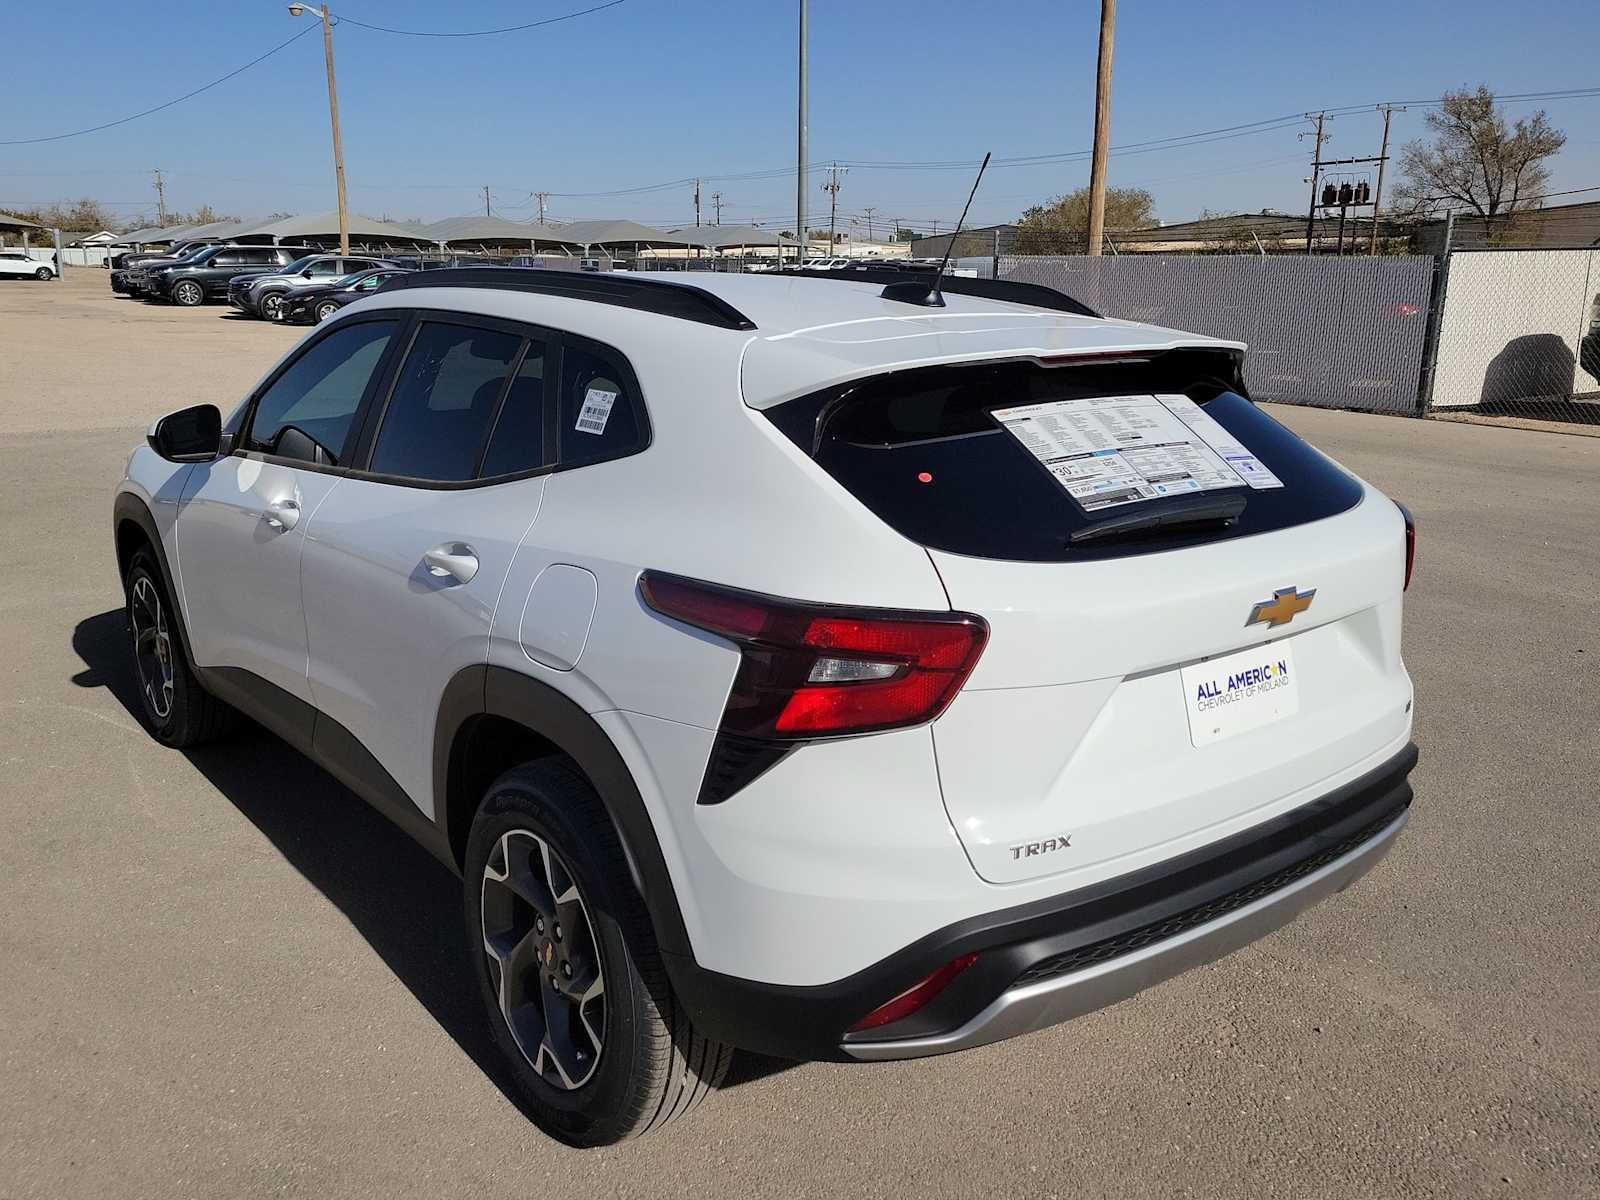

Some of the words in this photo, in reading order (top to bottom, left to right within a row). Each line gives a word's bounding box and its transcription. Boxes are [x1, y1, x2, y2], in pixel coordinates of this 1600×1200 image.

[1197, 680, 1222, 701] ALL
[1227, 660, 1287, 692] AMERICN
[1197, 690, 1244, 712] CHEVROLET
[1246, 686, 1257, 697] OF
[1257, 676, 1289, 694] MIDLAND
[1010, 834, 1072, 860] TRAX
